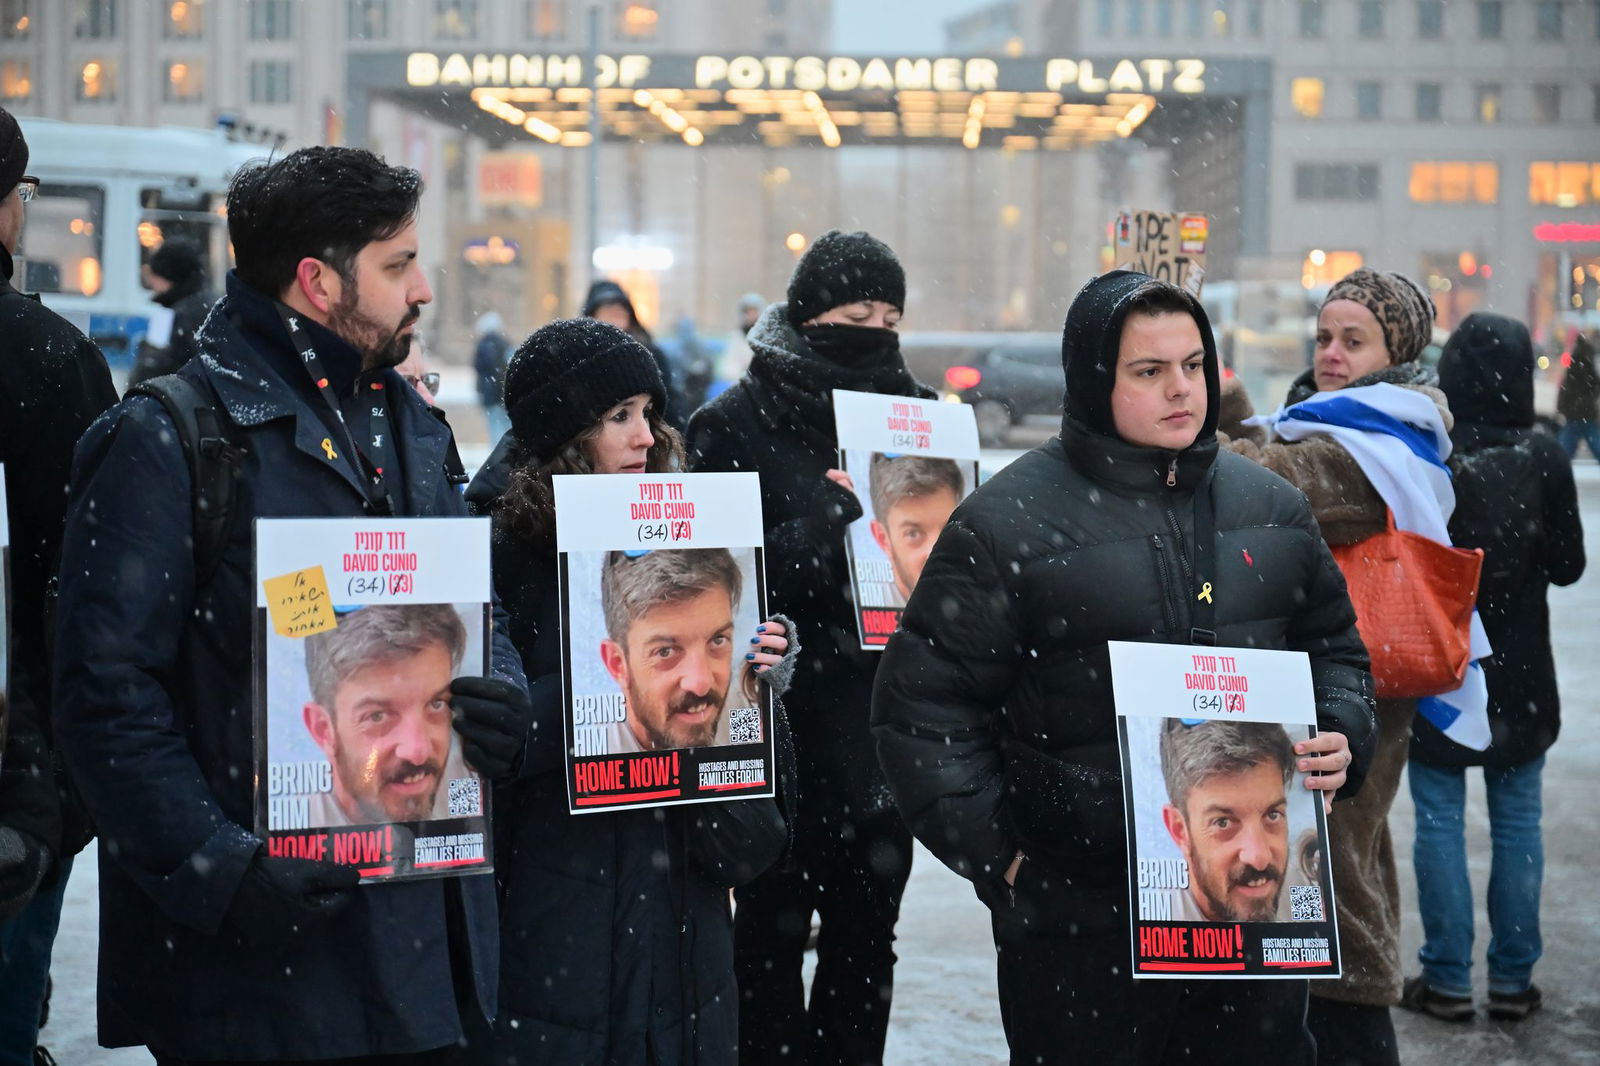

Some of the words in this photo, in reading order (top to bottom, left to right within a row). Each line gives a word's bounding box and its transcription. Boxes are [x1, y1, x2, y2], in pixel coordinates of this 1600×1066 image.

[407, 52, 652, 88] BAHNHOF
[695, 55, 1000, 91] POTSDAMER
[1046, 58, 1206, 93] PLATZ
[301, 348, 316, 362] 75
[371, 407, 384, 417] 75
[639, 483, 664, 502] קוניו
[666, 483, 684, 500] דוד
[630, 503, 662, 520] DAVID
[664, 502, 695, 519] CUNIO
[355, 532, 383, 552] קוניו
[386, 531, 406, 550] דוד
[637, 523, 669, 543] (34)
[343, 554, 379, 572] DAVID
[382, 553, 417, 572] CUNIO
[347, 576, 386, 597] (34)
[1192, 655, 1216, 673] קוניו
[1219, 656, 1236, 673] דוד
[1185, 673, 1216, 691] DAVID
[1218, 674, 1248, 693] CUNIO
[574, 692, 627, 726] BRING
[1193, 694, 1223, 713] (34)
[574, 727, 608, 757] HIM
[575, 760, 625, 793] HOME
[629, 751, 681, 788] NOW!
[699, 761, 727, 772] HOSTAGES
[727, 760, 739, 770] AND
[739, 758, 764, 769] MISSING
[269, 760, 334, 797] BRING
[699, 771, 735, 786] FAMILIES
[736, 769, 765, 784] FORUM
[269, 796, 310, 831] HIM
[333, 825, 393, 865] NOW!
[414, 835, 445, 849] HOSTAGES
[445, 834, 458, 847] AND
[457, 833, 484, 846] MISSING
[414, 847, 453, 864] FAMILIES
[454, 844, 484, 861] FORUM
[1138, 858, 1190, 889] BRING
[1139, 890, 1172, 921] HIM
[1139, 926, 1189, 958] HOME
[1192, 924, 1244, 959] NOW!
[1262, 938, 1290, 948] HOSTAGES
[1291, 938, 1303, 948] AND
[1303, 938, 1329, 948] MISSING
[1263, 949, 1300, 963] FAMILIES
[1300, 949, 1330, 962] FORUM
